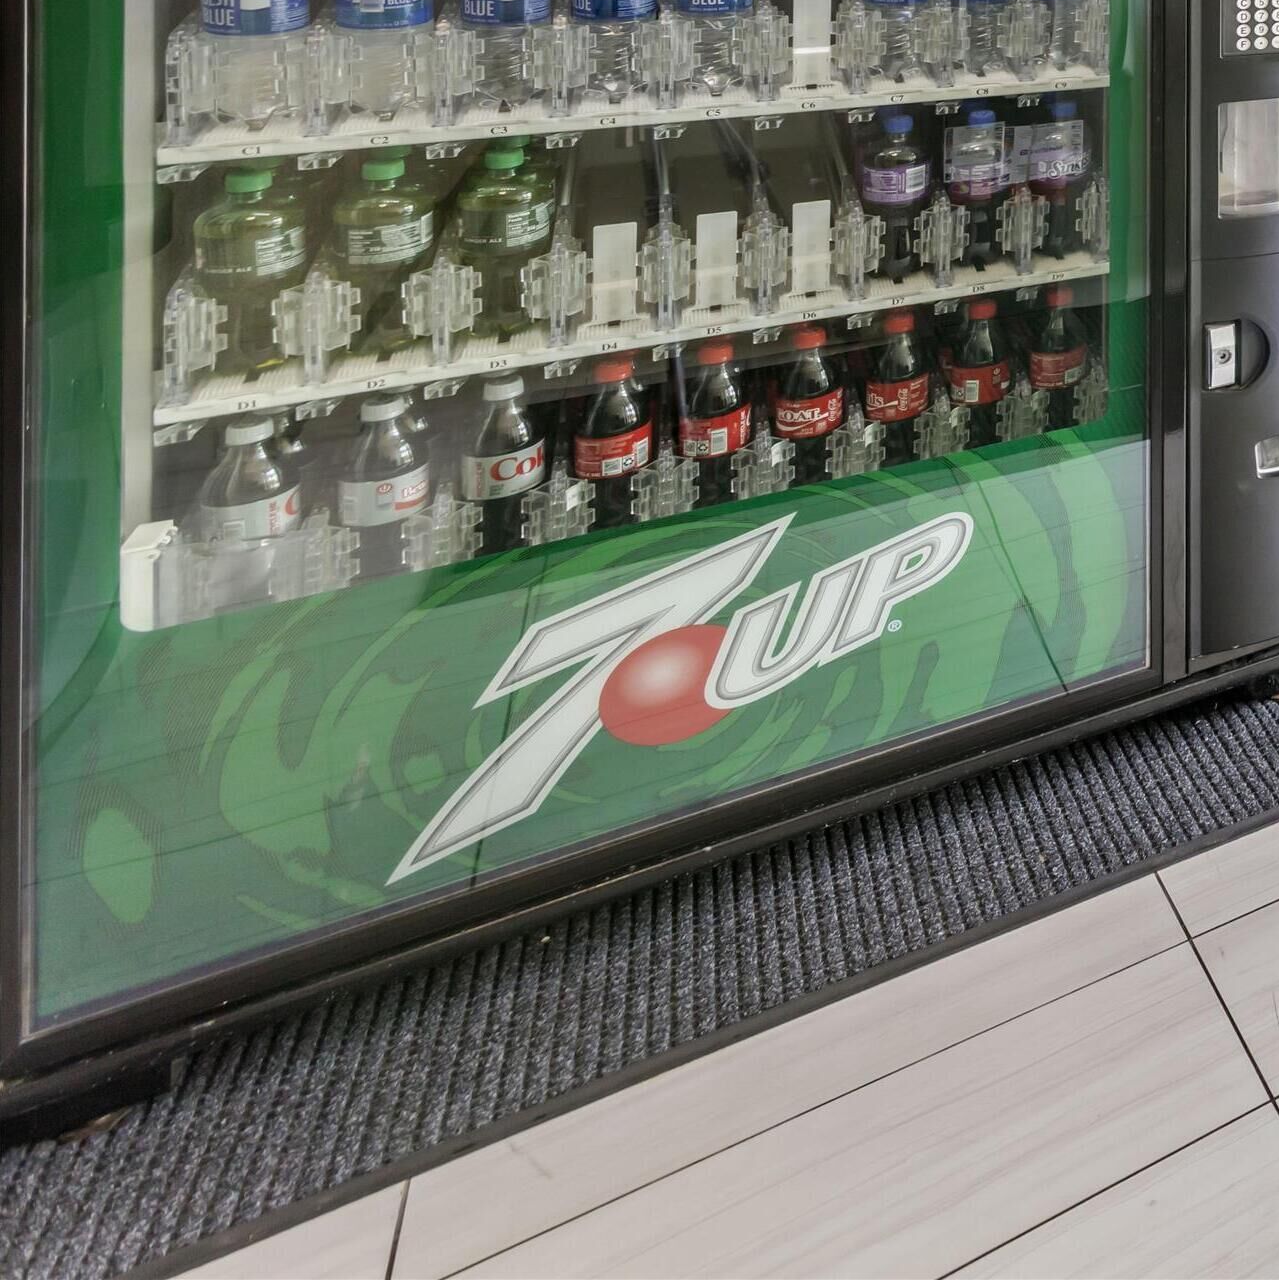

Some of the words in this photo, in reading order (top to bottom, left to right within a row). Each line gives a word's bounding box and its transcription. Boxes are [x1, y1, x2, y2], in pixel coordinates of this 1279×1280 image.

[464, 0, 495, 16] BLUE
[890, 95, 904, 103] C7
[801, 101, 816, 110] C6
[706, 109, 721, 117] C5
[599, 117, 616, 125] C4
[490, 126, 508, 135] C3
[370, 136, 389, 145] C2
[242, 146, 260, 155] C1
[972, 285, 985, 293] D8
[891, 297, 904, 305] D7
[802, 311, 817, 319] D6
[707, 326, 722, 335] D5
[601, 342, 618, 351] D4
[489, 359, 507, 369] D3
[367, 379, 386, 388] D2
[237, 400, 257, 410] D1
